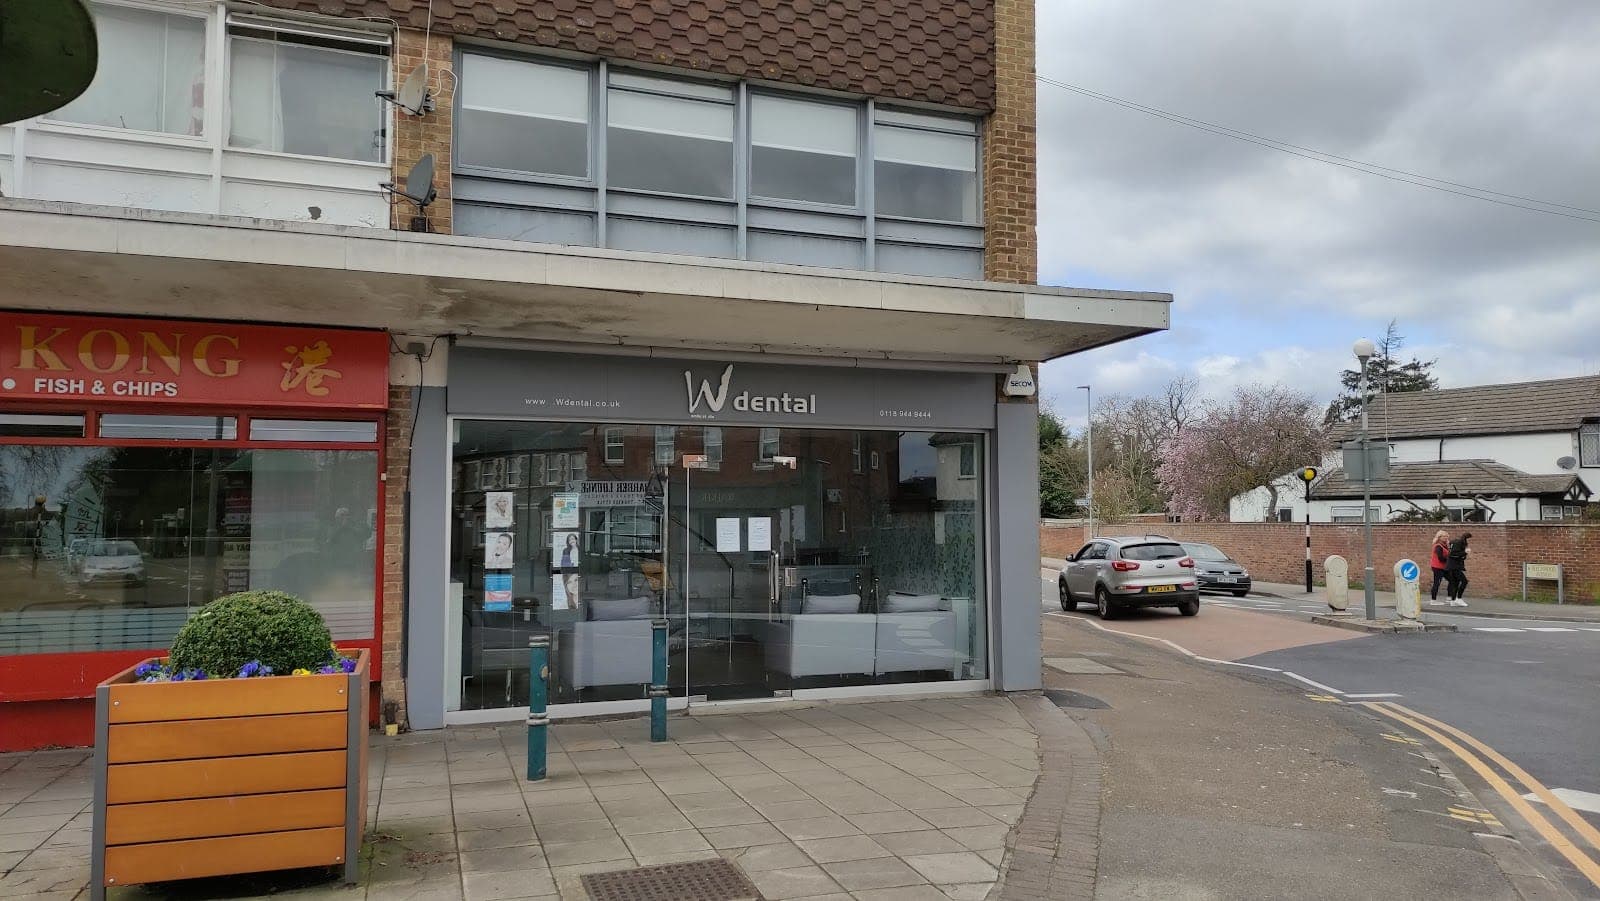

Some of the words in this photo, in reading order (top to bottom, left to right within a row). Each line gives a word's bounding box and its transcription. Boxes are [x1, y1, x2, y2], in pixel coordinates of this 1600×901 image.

[13, 324, 243, 378] KONG
[34, 378, 85, 394] FISH
[91, 379, 106, 395] &
[112, 380, 178, 397] CHIPS
[684, 364, 734, 413] W
[733, 390, 816, 414] dental
[879, 409, 897, 417] 0118
